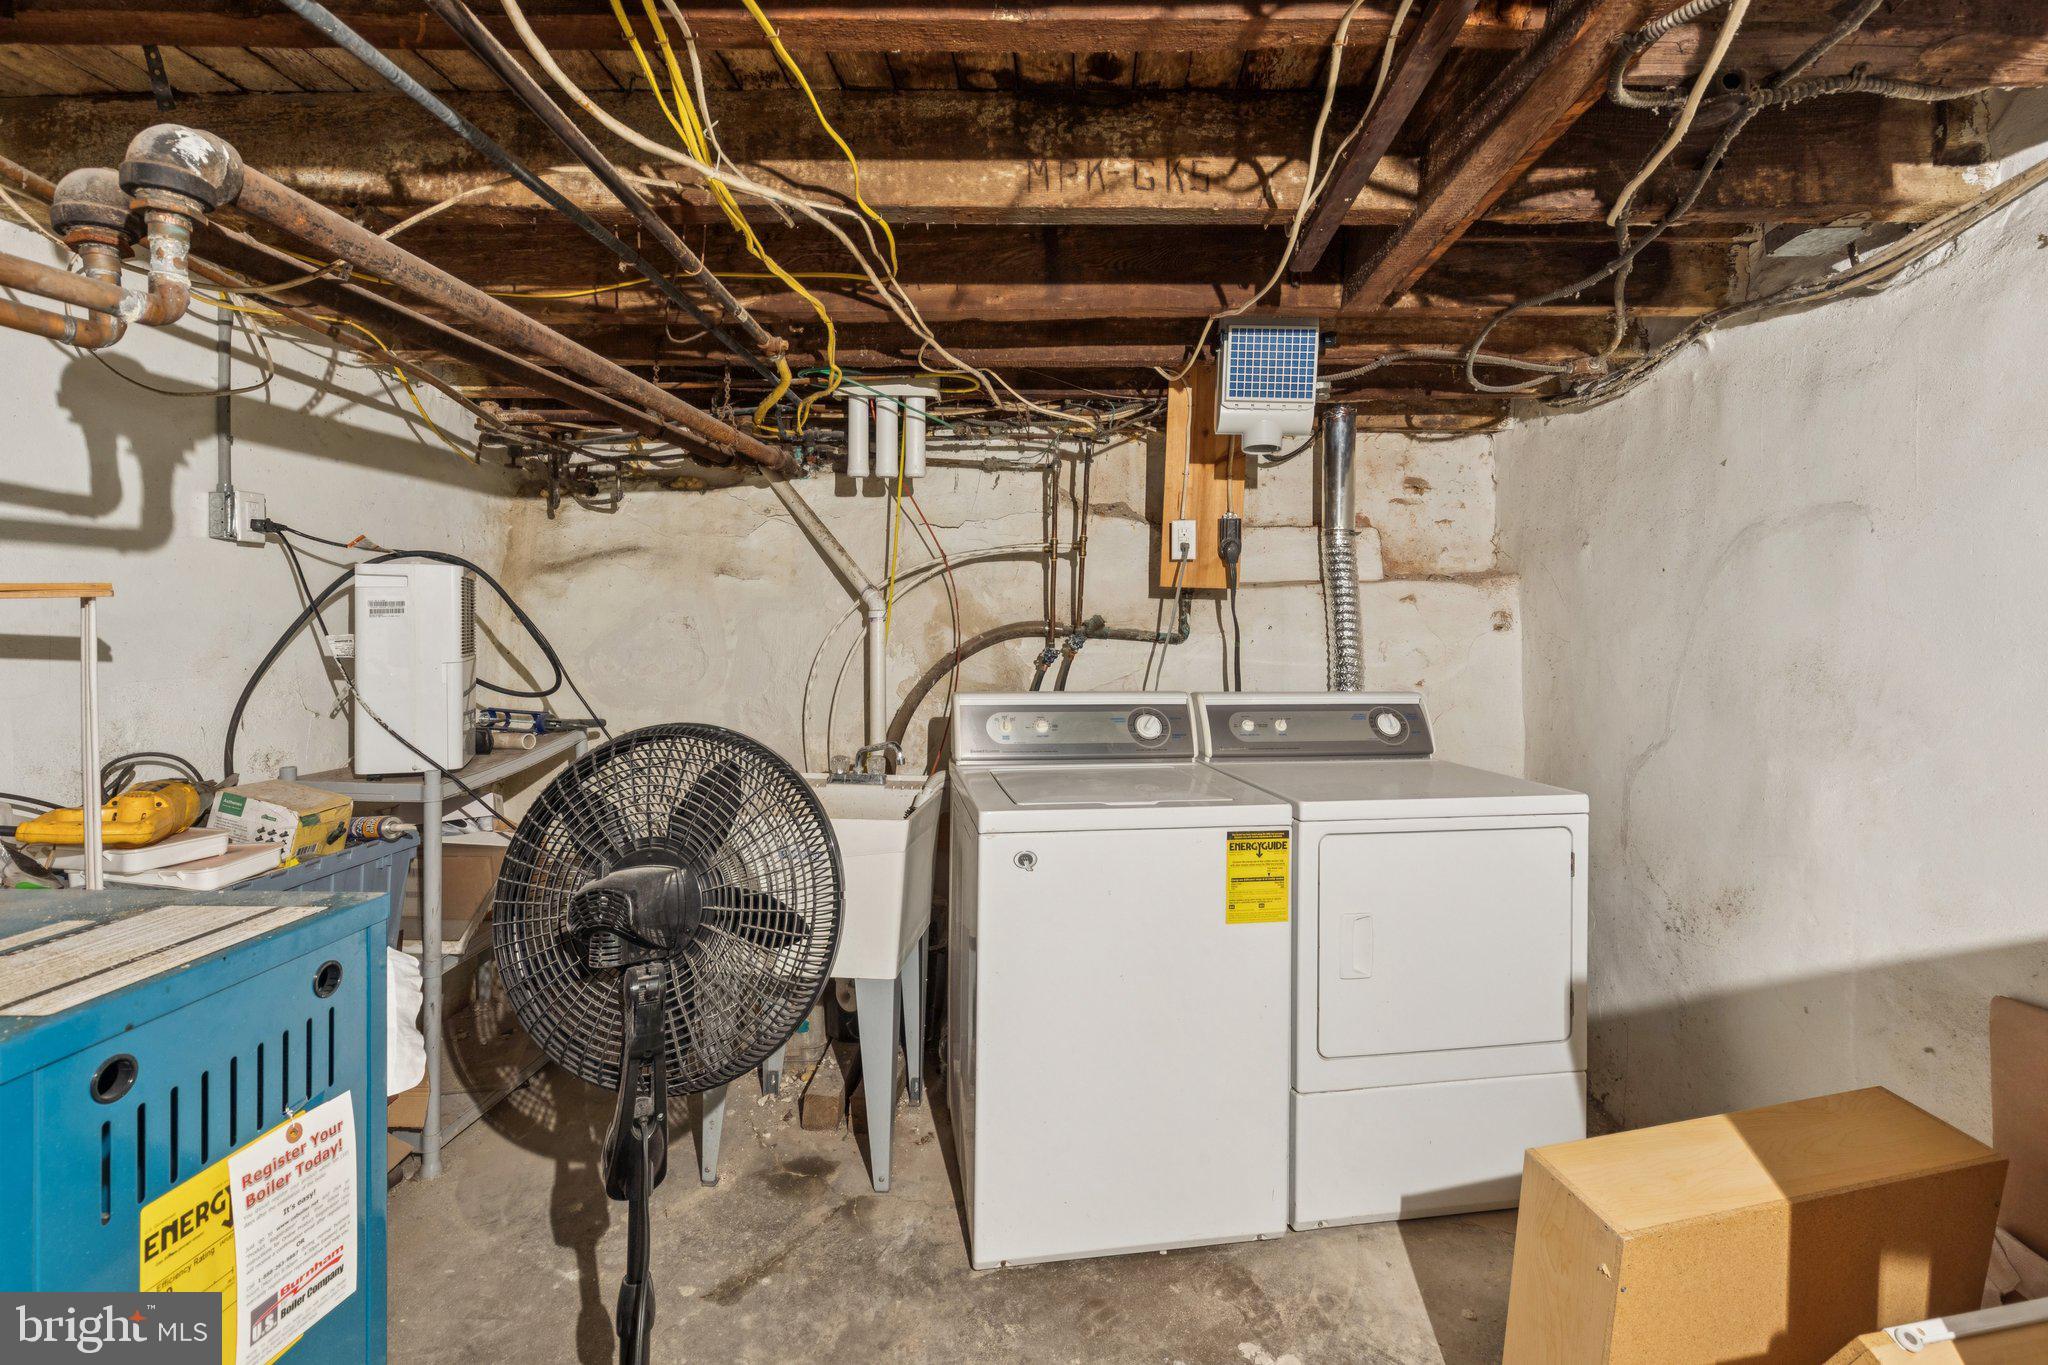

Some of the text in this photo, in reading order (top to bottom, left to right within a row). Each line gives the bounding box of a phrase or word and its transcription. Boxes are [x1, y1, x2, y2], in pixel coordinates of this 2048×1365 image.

[1229, 840, 1288, 852] ENERGYGUIDE
[242, 1142, 307, 1190] Register
[310, 1120, 343, 1147] Your
[246, 1172, 292, 1209] Boiler
[295, 1138, 342, 1177] Today!
[297, 1189, 316, 1207] easy!
[193, 1247, 216, 1267] Rating
[280, 1244, 344, 1297] Burnham
[252, 1264, 344, 1342] U.S. Boiler Company
